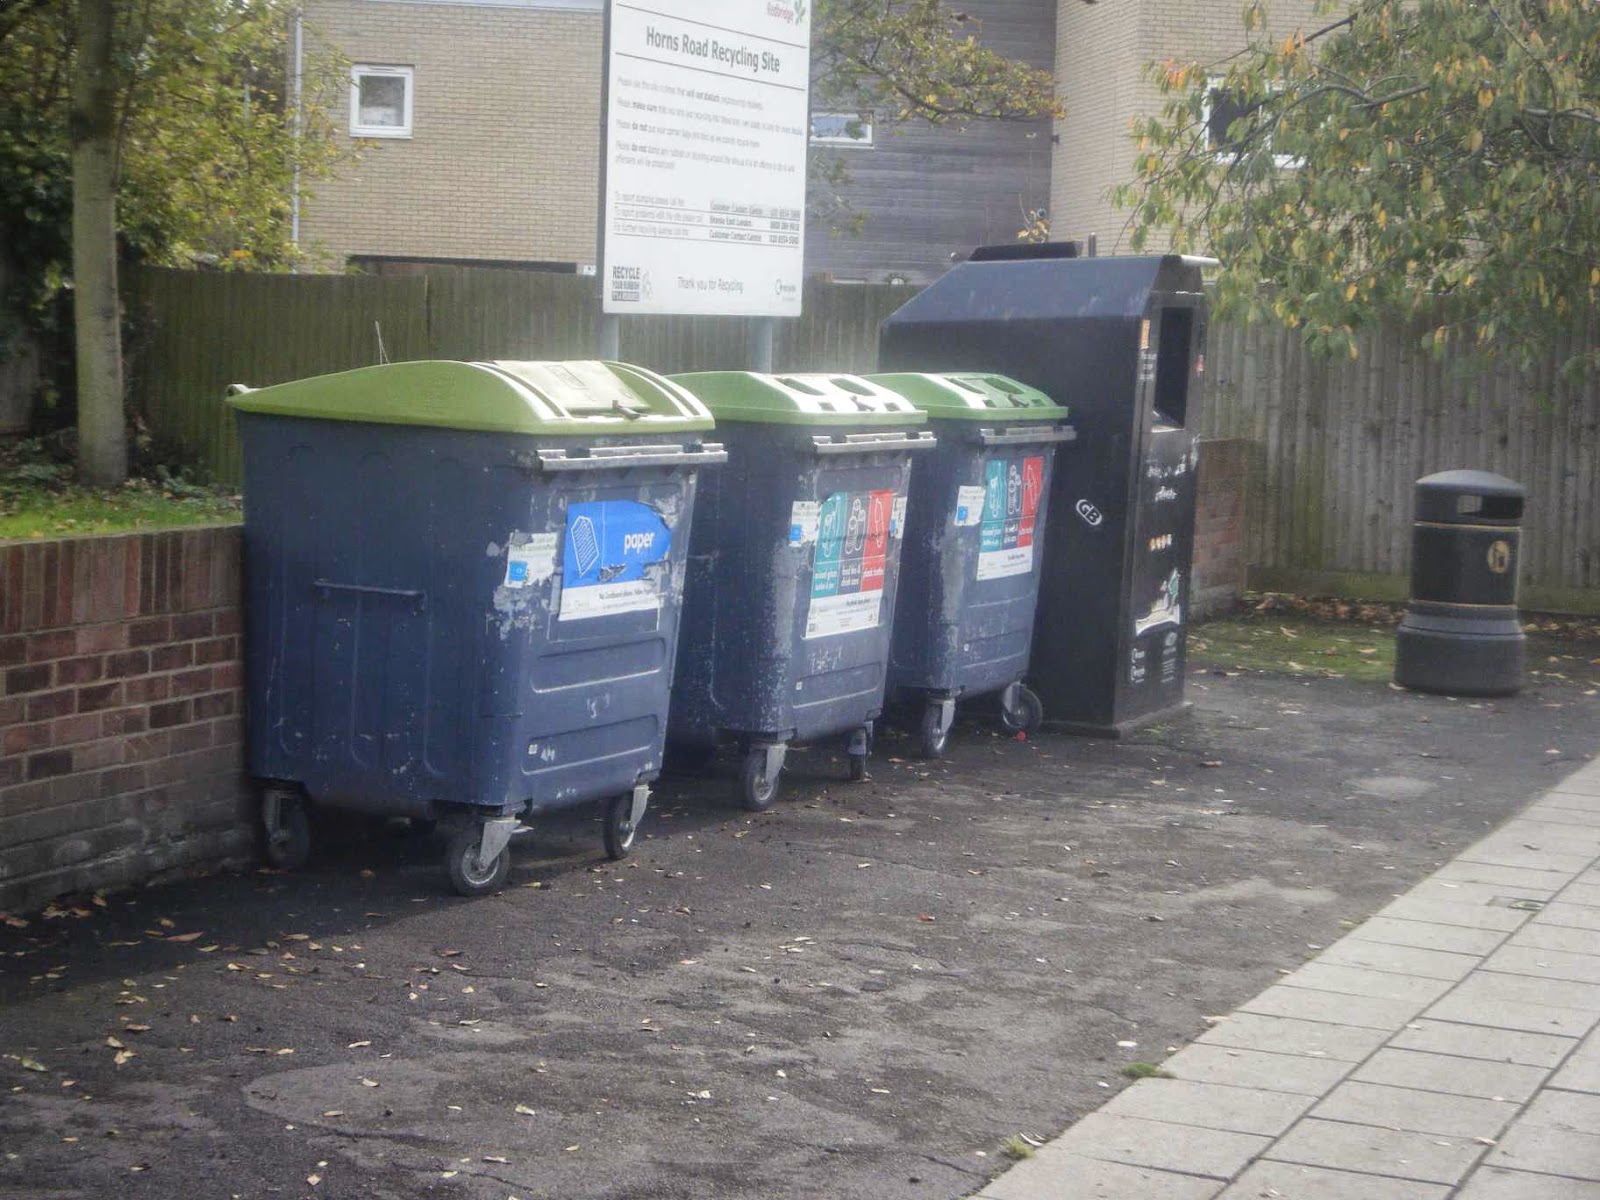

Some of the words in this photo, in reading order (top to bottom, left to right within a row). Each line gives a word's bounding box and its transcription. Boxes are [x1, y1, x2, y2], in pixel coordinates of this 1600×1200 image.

[646, 26, 679, 51] Horns
[682, 34, 708, 58] Road
[711, 40, 759, 73] Recycling
[761, 51, 780, 73] Site
[612, 266, 640, 279] RECYCLE
[677, 276, 694, 288] Thank
[697, 280, 707, 292] you
[708, 280, 717, 290] for
[718, 278, 744, 294] Recycling
[624, 532, 655, 555] paper
